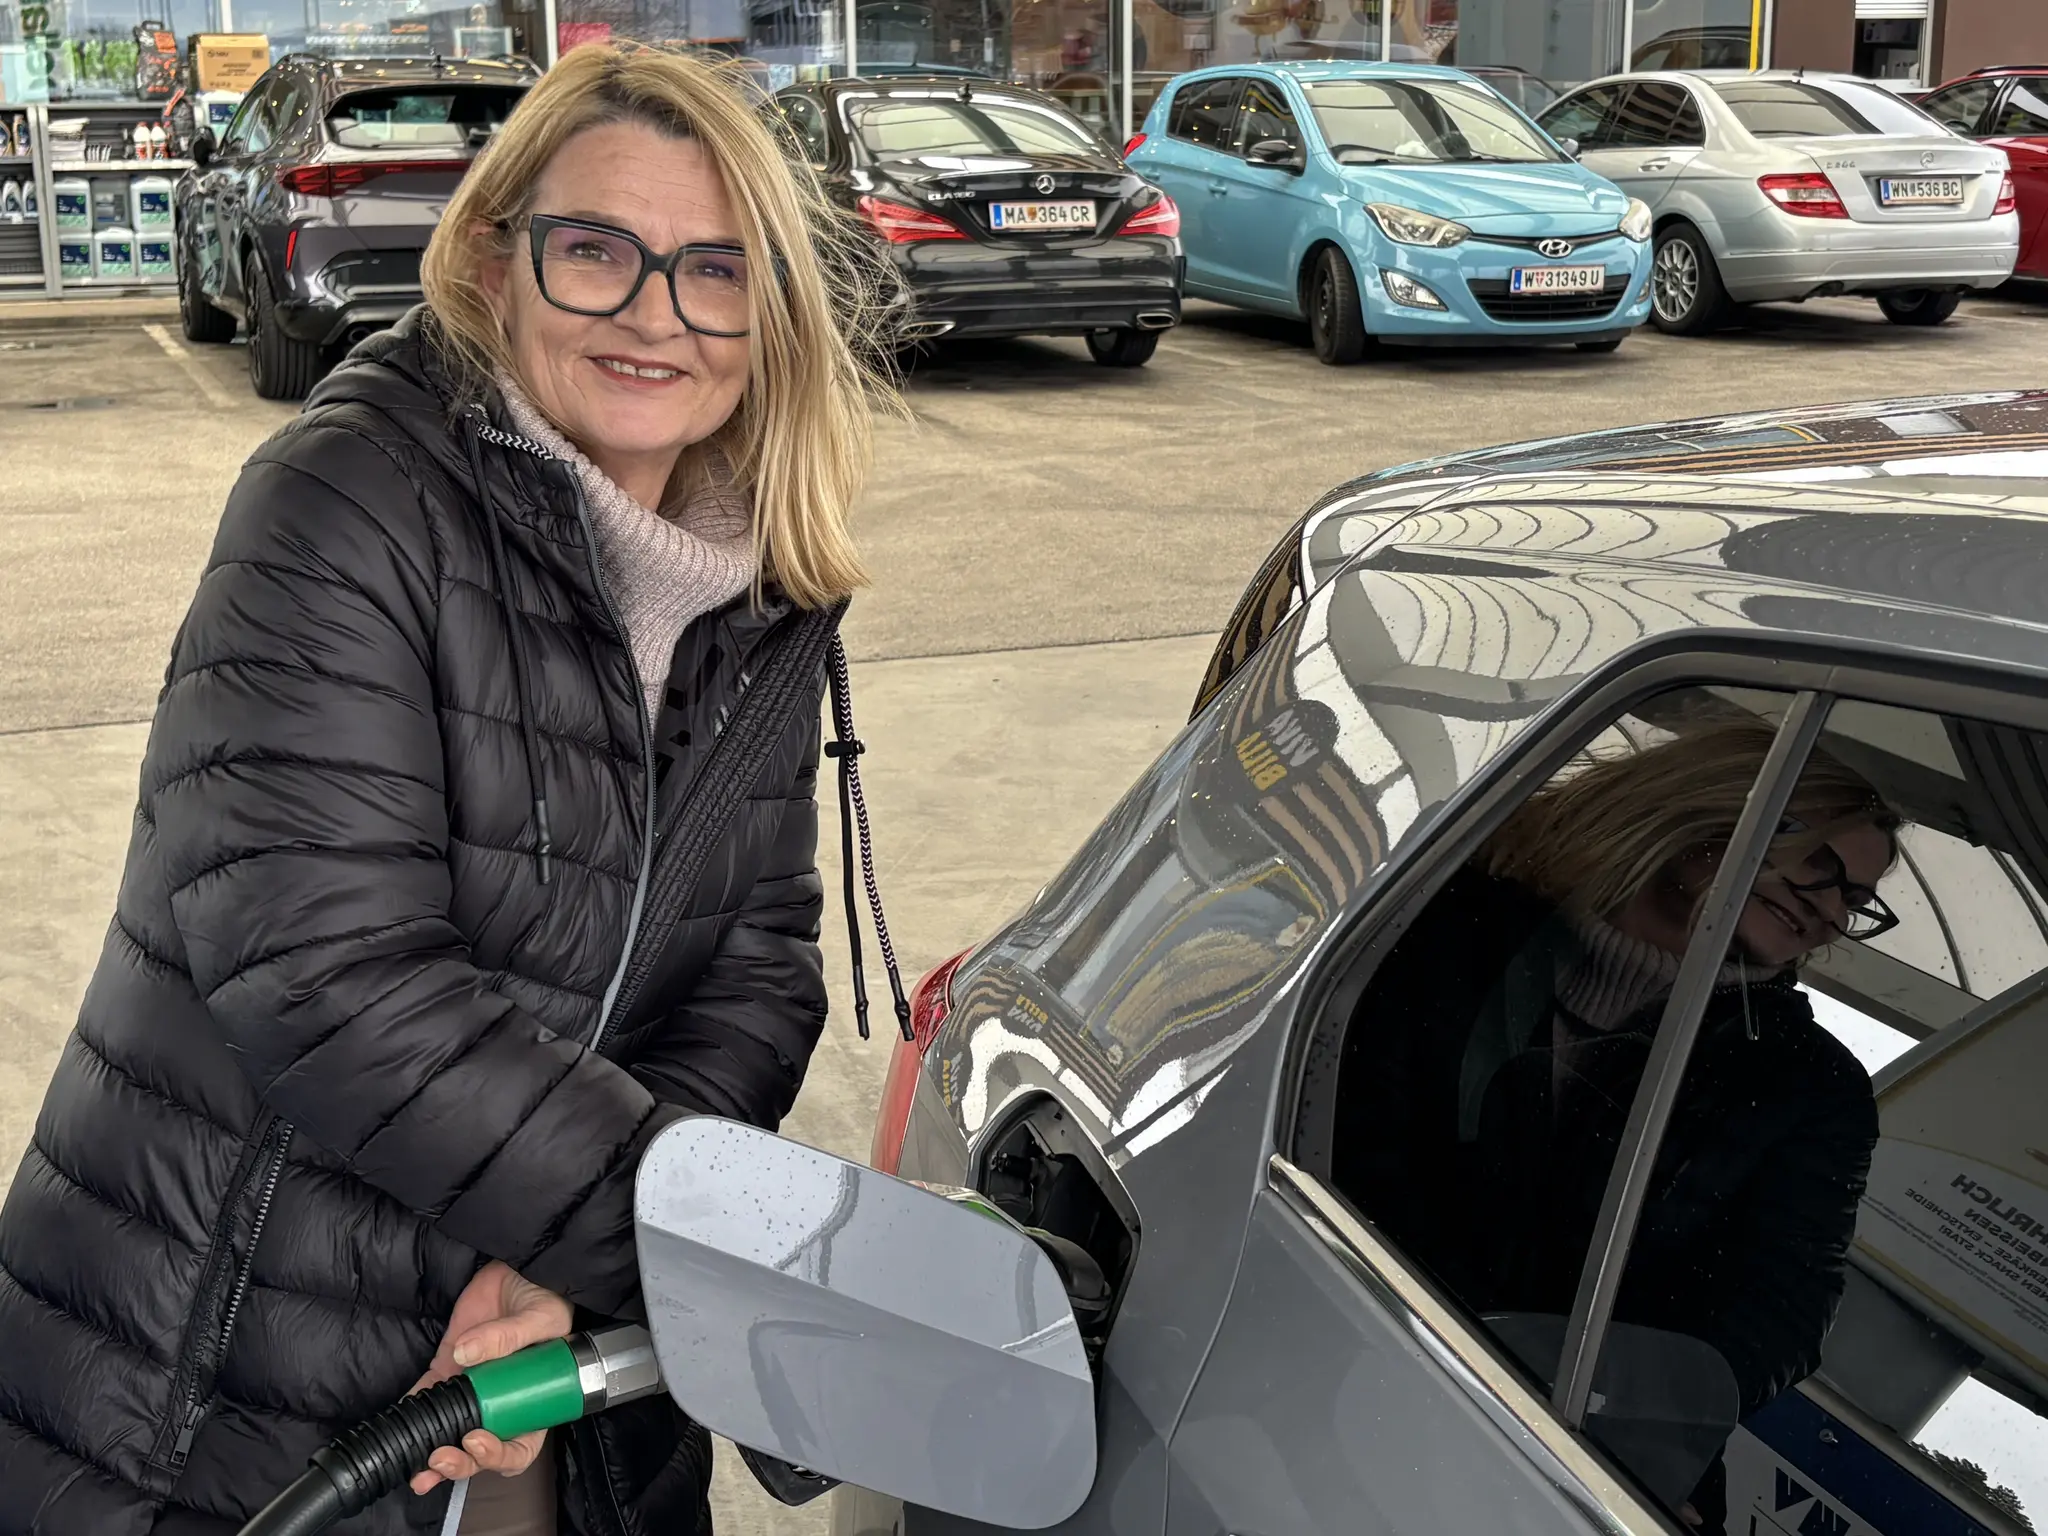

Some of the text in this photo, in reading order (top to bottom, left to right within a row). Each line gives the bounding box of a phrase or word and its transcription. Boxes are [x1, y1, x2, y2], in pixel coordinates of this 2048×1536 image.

[1890, 181, 1960, 197] WN 536 BC
[1004, 206, 1090, 223] MA 364 CR
[1524, 270, 1600, 288] W 31349 U
